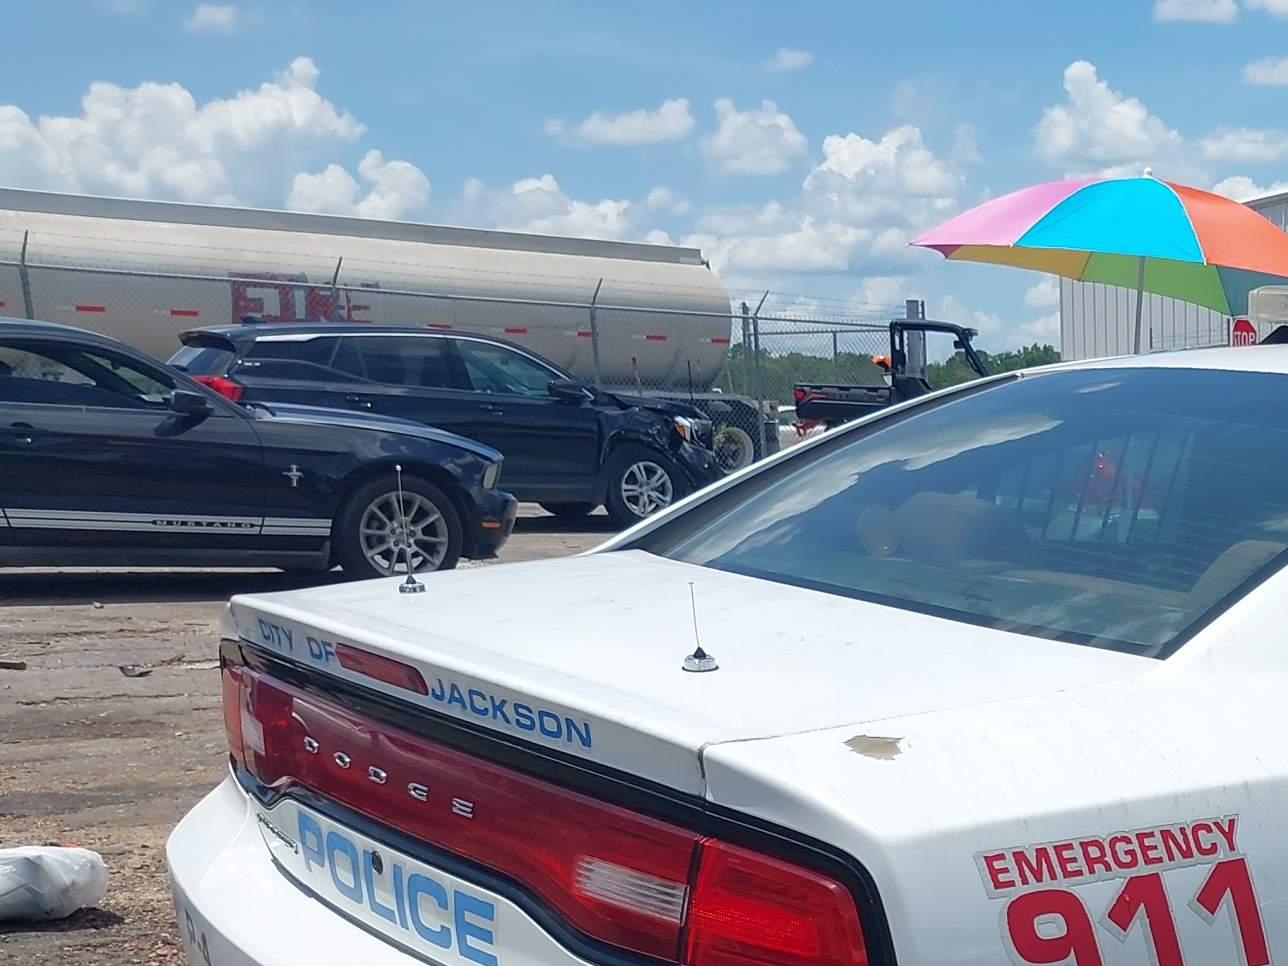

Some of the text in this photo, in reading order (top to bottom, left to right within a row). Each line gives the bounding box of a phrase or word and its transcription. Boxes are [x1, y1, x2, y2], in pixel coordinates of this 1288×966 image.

[156, 519, 252, 529] MUSTANG
[257, 618, 592, 748] CITY OF JACKSON
[304, 736, 475, 820] DODGE
[983, 817, 1239, 891] EMERGENCY
